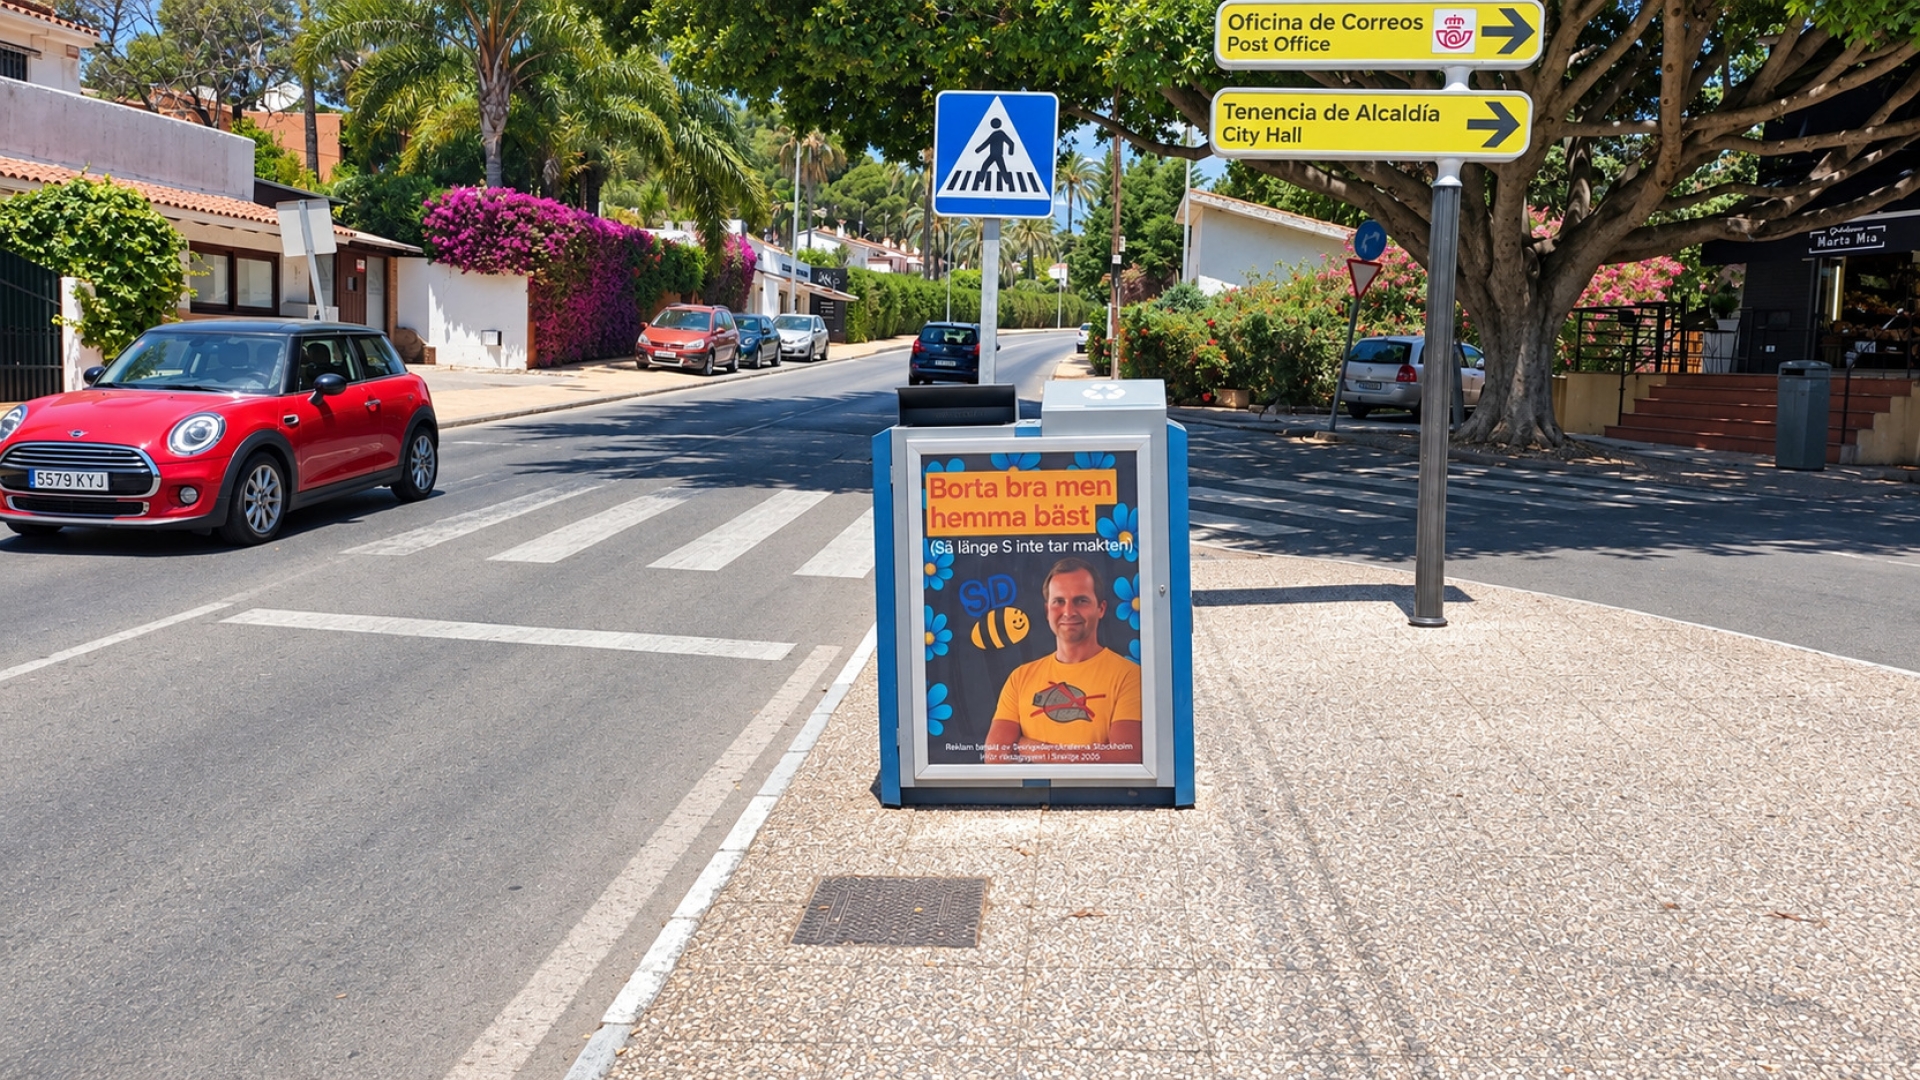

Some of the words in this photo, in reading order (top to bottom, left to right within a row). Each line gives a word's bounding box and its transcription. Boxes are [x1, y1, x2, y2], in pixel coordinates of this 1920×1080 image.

[1228, 13, 1302, 31] Oficina
[1309, 13, 1335, 31] de
[1341, 13, 1424, 31] Correos
[1227, 36, 1268, 52] Post
[1274, 35, 1331, 52] Office
[1223, 103, 1317, 121] Tenencia
[1323, 104, 1350, 121] de
[1355, 103, 1441, 122] Alcaldía
[1222, 126, 1260, 146] City
[1266, 126, 1302, 143] Hall
[37, 472, 73, 488] 5579
[76, 473, 105, 489] KYJ
[929, 477, 998, 500] Borta
[1005, 475, 1048, 498] bra
[1056, 478, 1112, 498] men
[931, 506, 1027, 529] hemma
[1034, 504, 1090, 527] bäst
[930, 538, 954, 557] (Så
[958, 540, 999, 557] länge
[1002, 540, 1013, 554] S
[1016, 539, 1044, 554] inte
[1048, 539, 1070, 553] tar
[1073, 537, 1134, 554] makten)
[945, 743, 974, 751] Reklam
